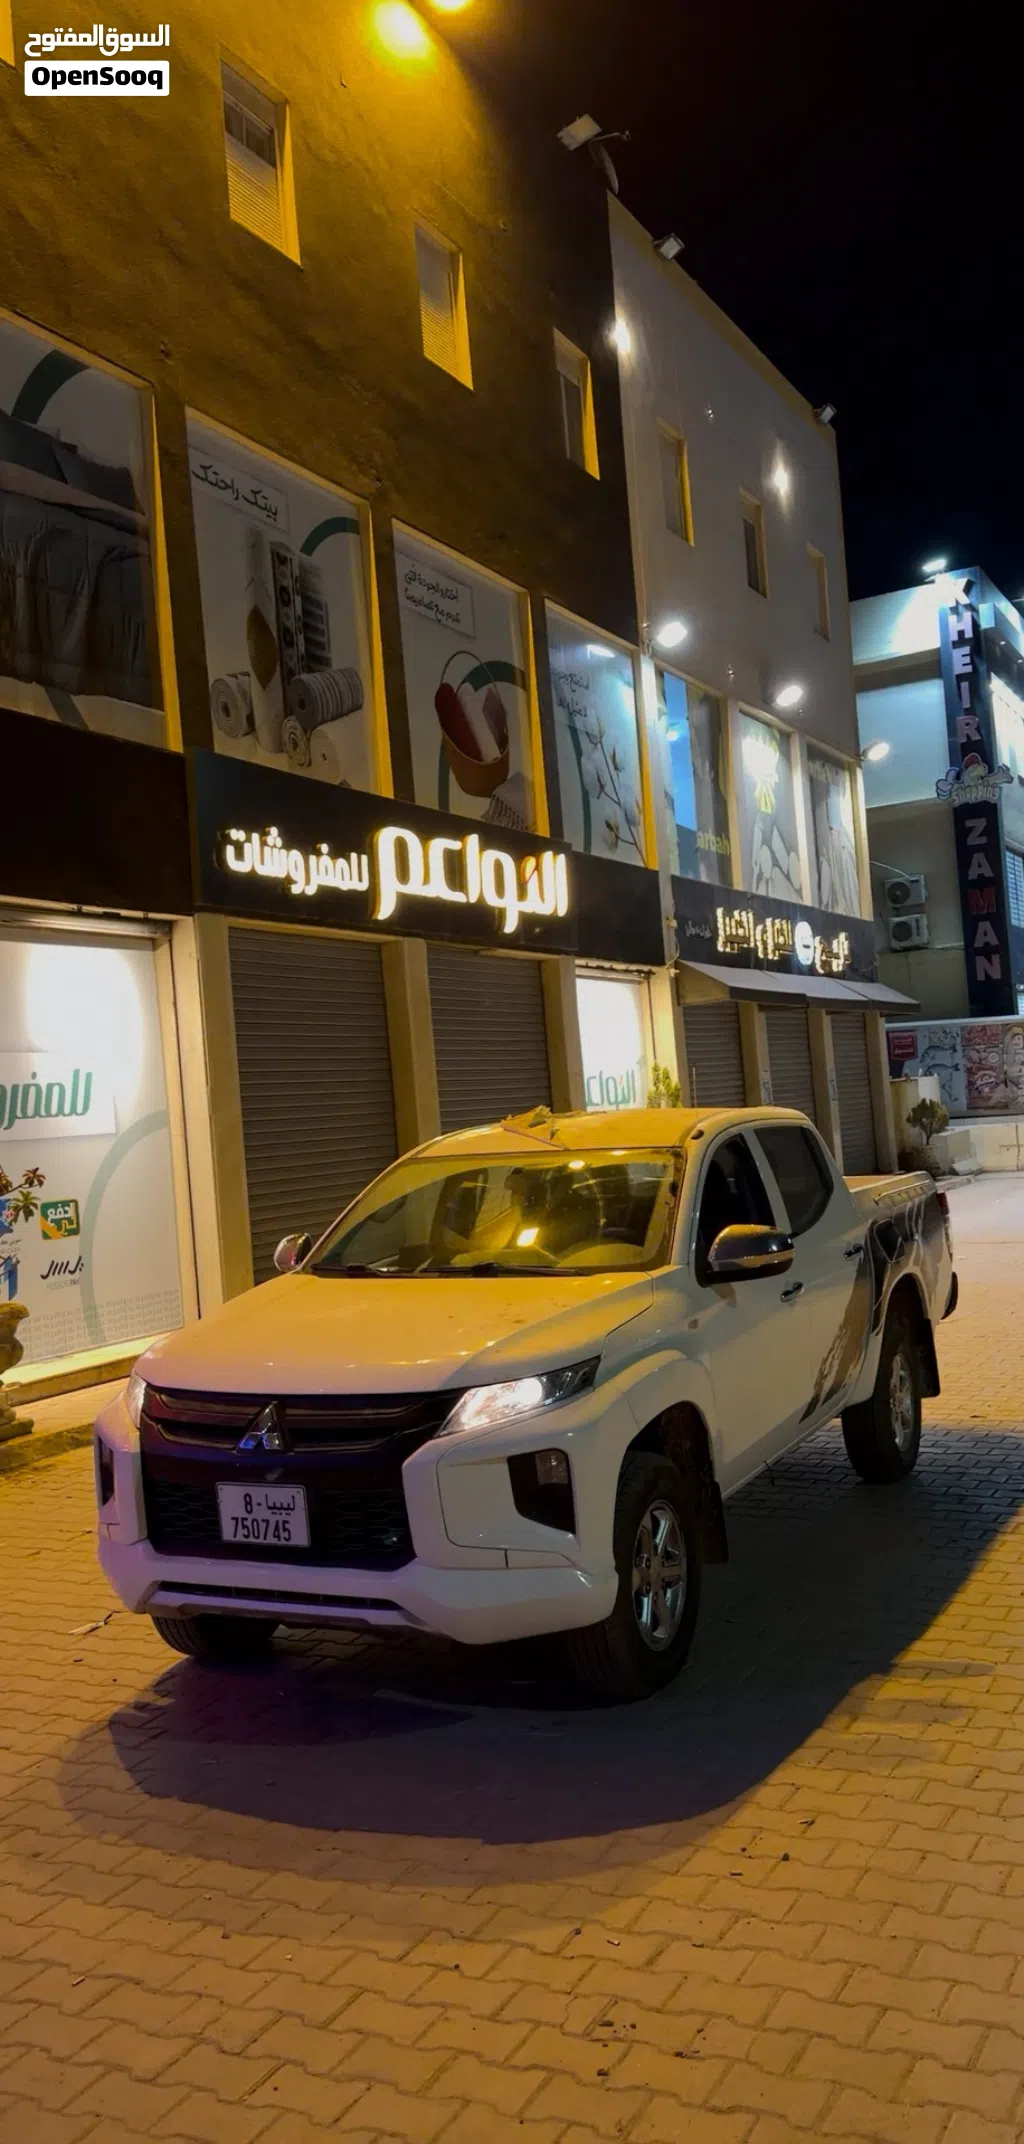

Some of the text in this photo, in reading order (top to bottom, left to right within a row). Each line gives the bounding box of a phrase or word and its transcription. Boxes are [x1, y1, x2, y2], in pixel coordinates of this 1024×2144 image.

[943, 576, 982, 743] KHEIR
[224, 825, 567, 934] النواعم للمفروشات
[964, 817, 1001, 981] ZAMAN
[231, 1517, 291, 1542] 750745
